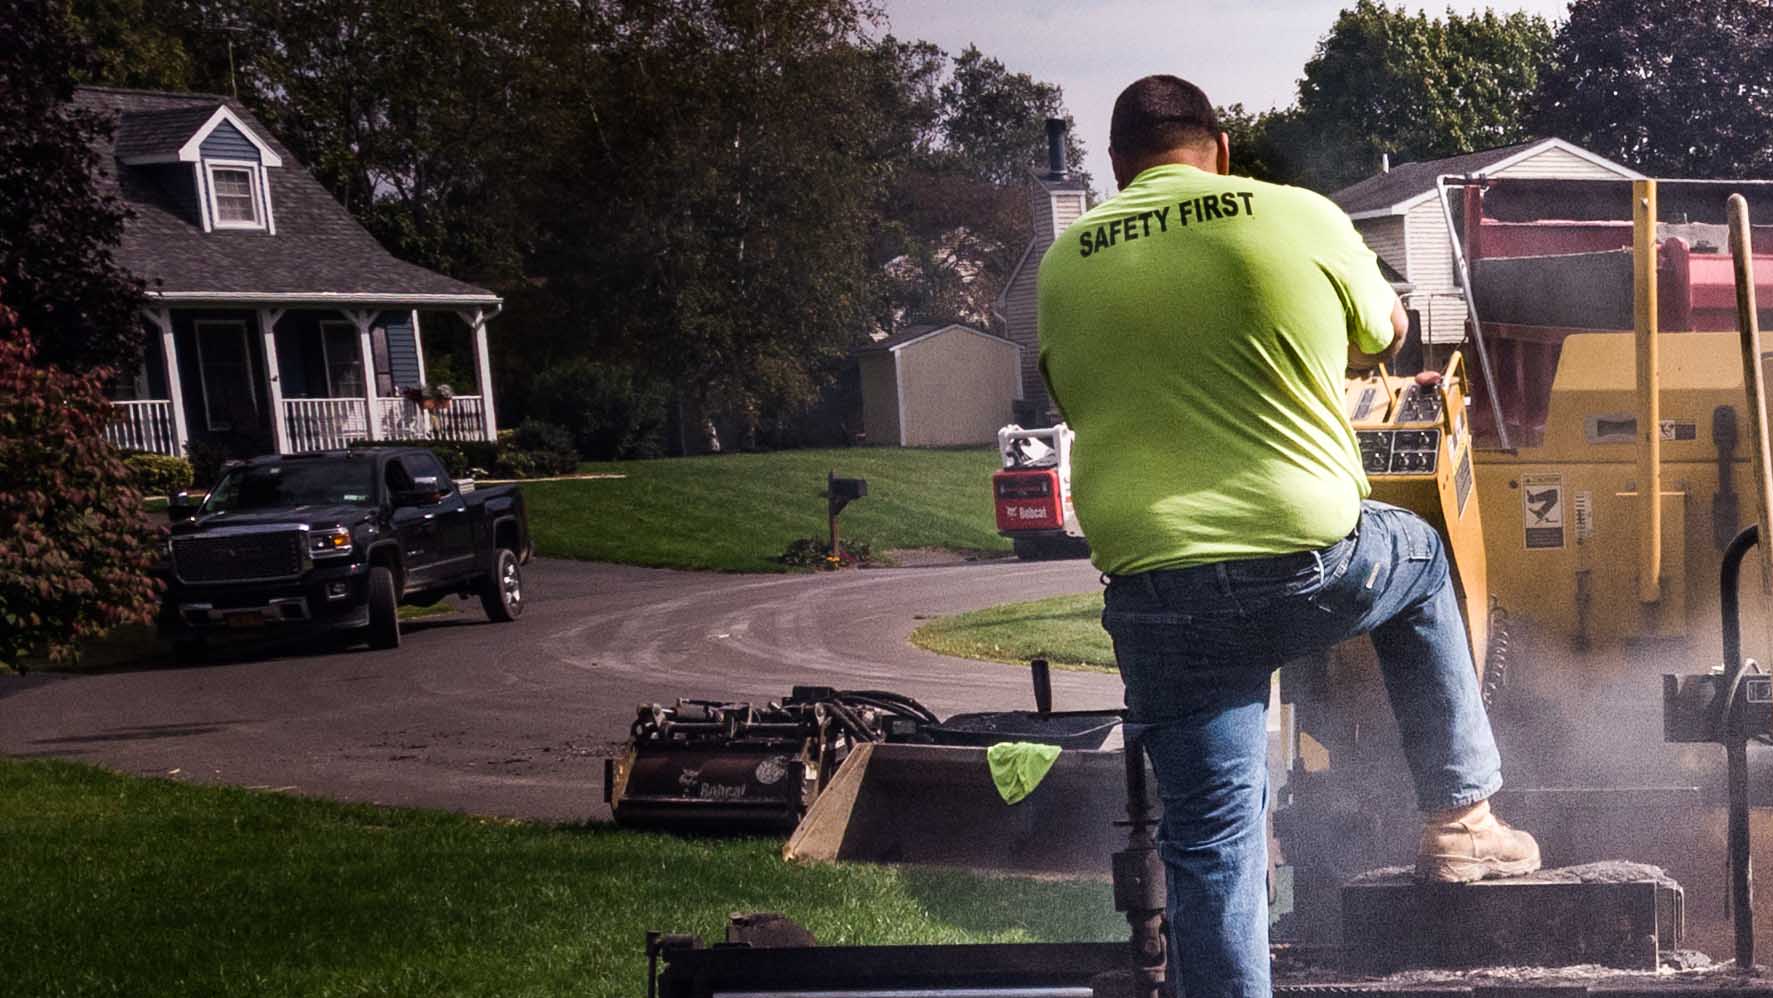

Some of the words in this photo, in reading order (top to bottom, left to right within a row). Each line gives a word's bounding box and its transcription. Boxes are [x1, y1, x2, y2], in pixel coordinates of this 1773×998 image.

[1079, 207, 1170, 258] SAFETY
[1180, 192, 1254, 226] FIRST
[1019, 506, 1047, 519] Bobcat
